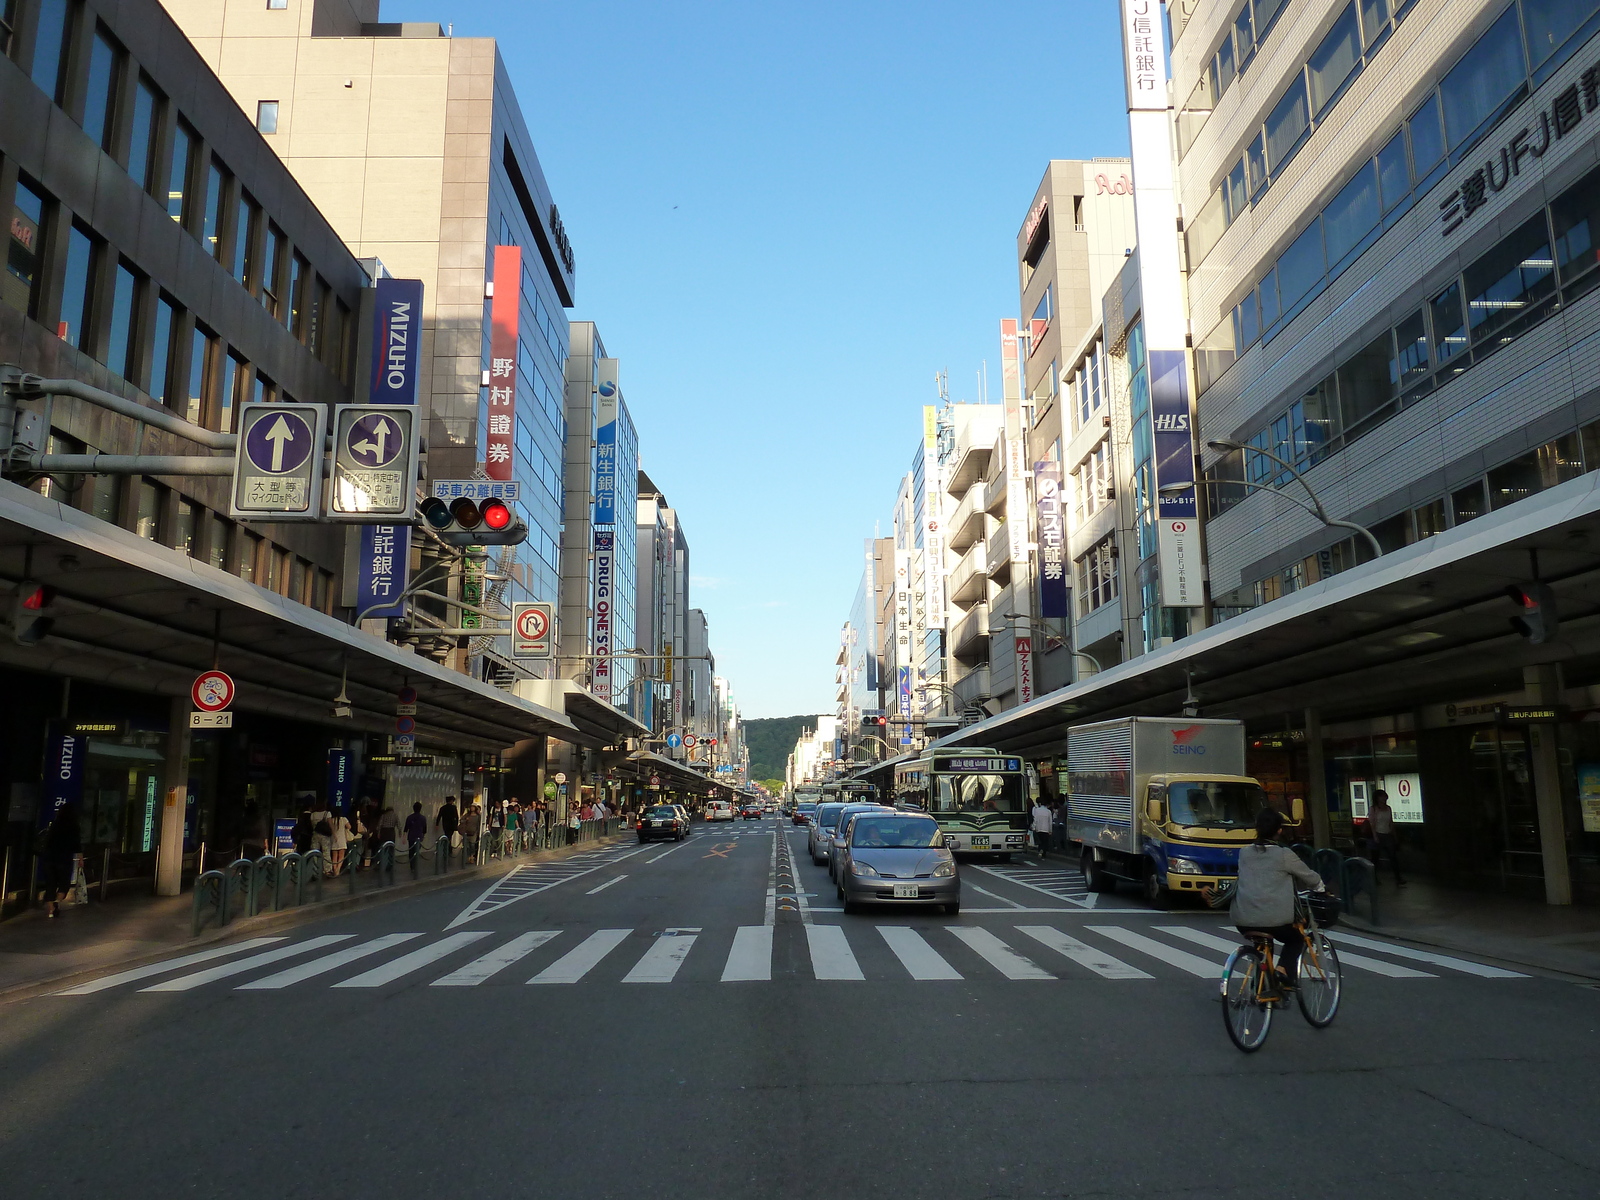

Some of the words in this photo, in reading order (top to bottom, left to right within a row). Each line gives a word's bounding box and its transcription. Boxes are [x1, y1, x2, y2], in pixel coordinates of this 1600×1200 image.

[387, 301, 411, 389] MIZUHO
[488, 357, 514, 464] 野村證券
[436, 482, 517, 499] 歩車分離信号
[597, 442, 615, 509] 新生銀行
[1042, 499, 1063, 580] コスモ証券
[598, 556, 609, 597] DRUG
[899, 591, 909, 646] 日本生命
[337, 755, 346, 783] MIZUHO
[1172, 745, 1206, 755] SEINO
